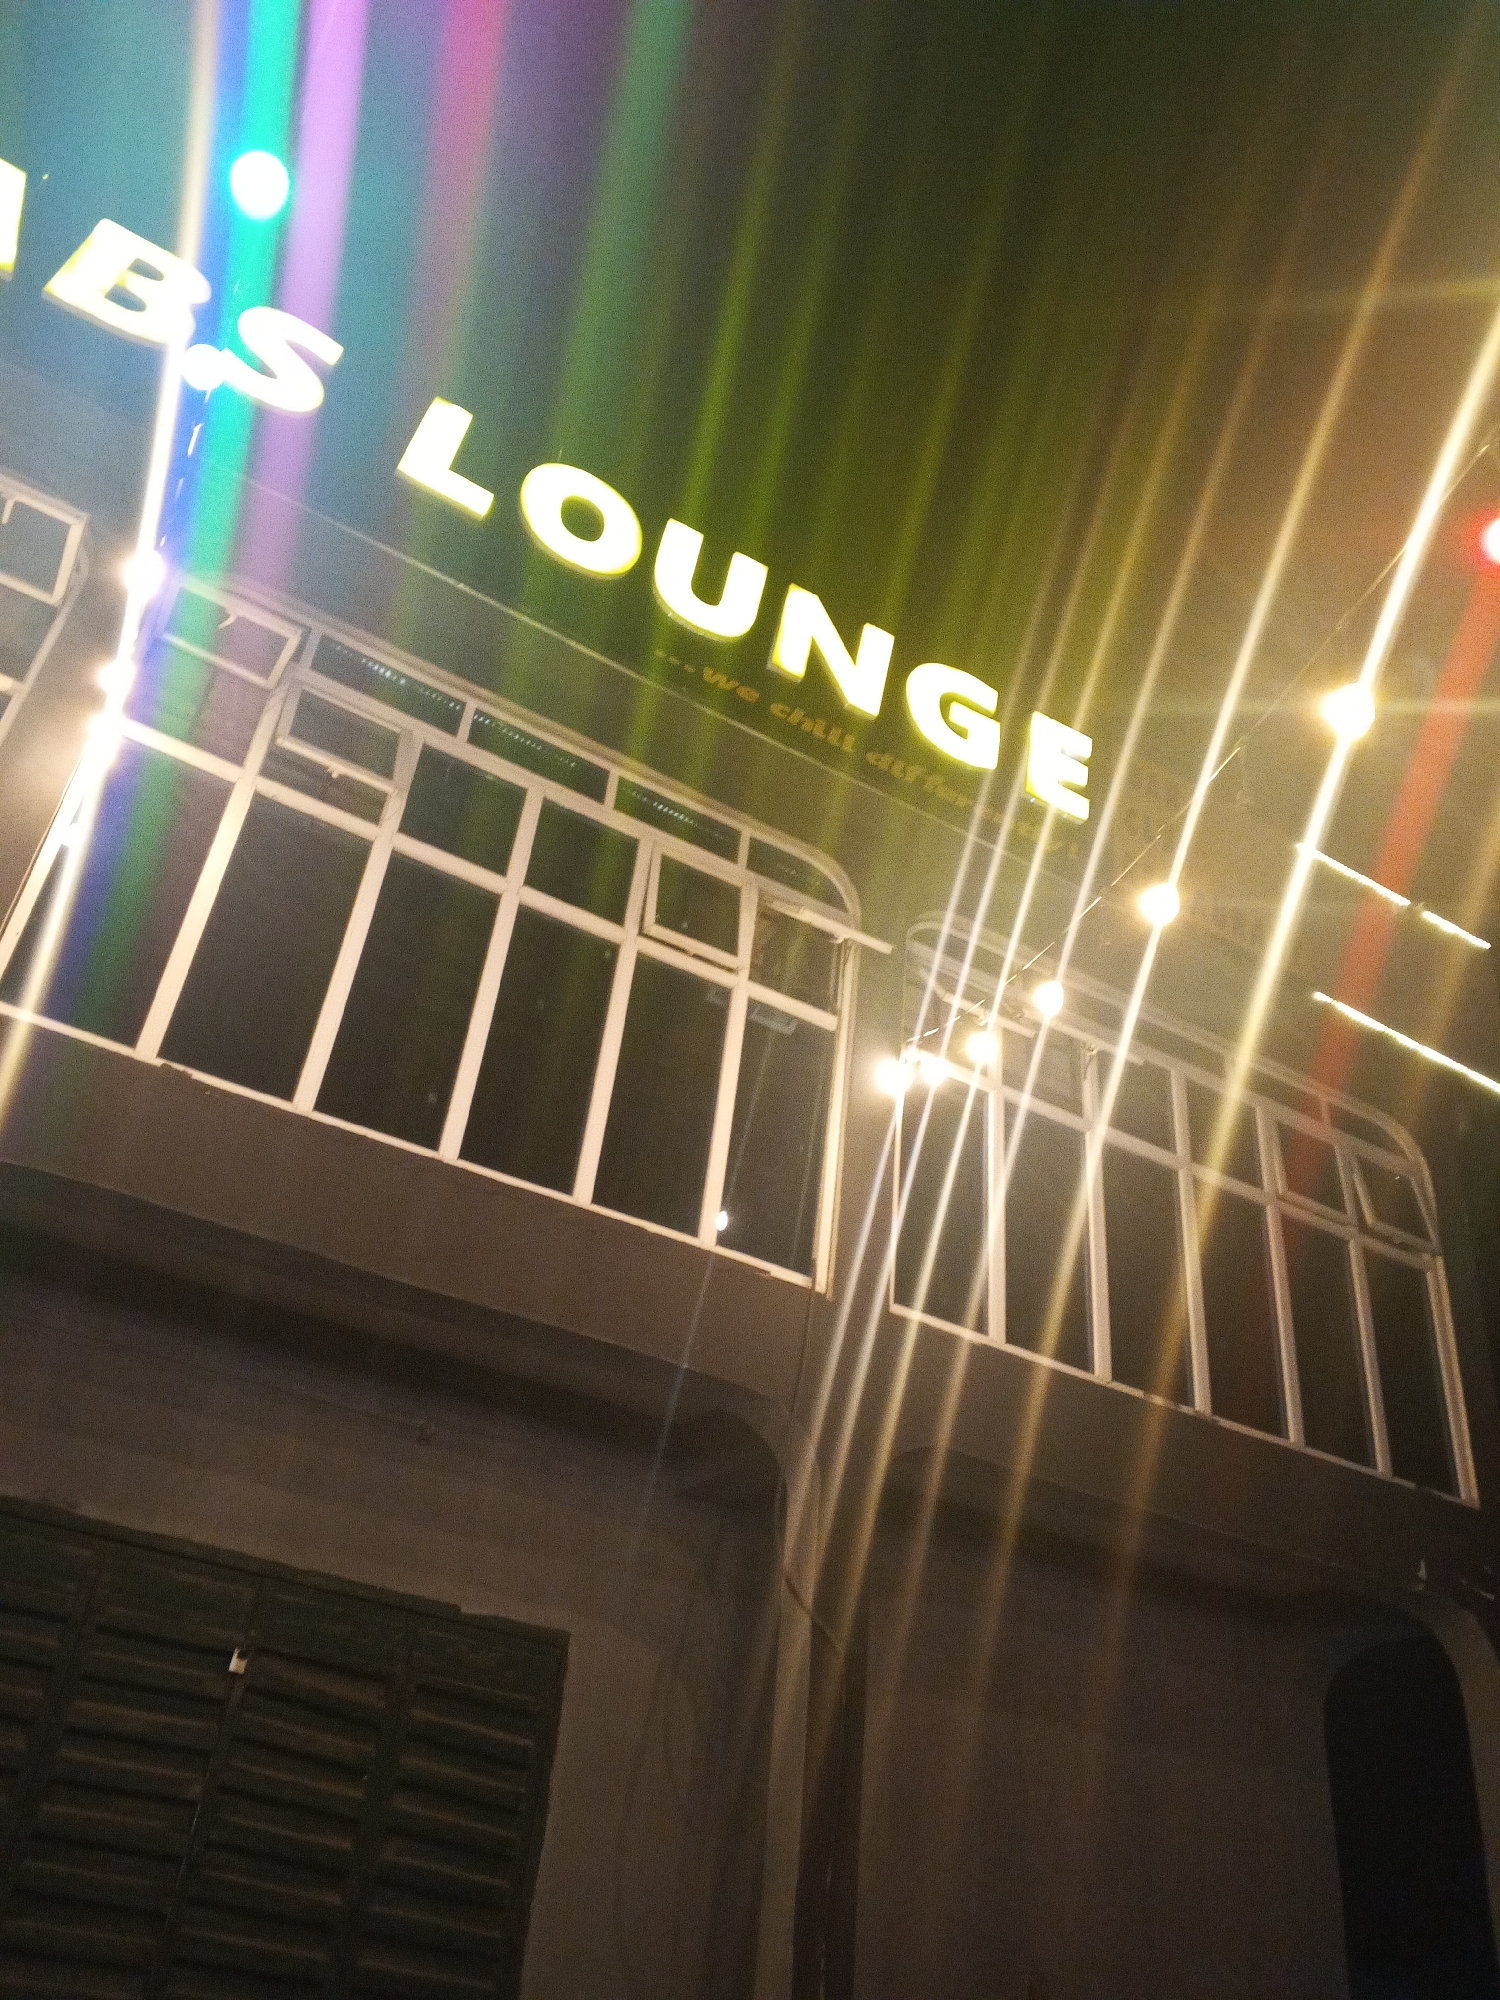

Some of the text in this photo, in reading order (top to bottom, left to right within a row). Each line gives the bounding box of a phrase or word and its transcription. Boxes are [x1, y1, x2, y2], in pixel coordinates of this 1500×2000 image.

[0, 158, 1092, 824] BS LOUNGE
[770, 702, 855, 755] chill
